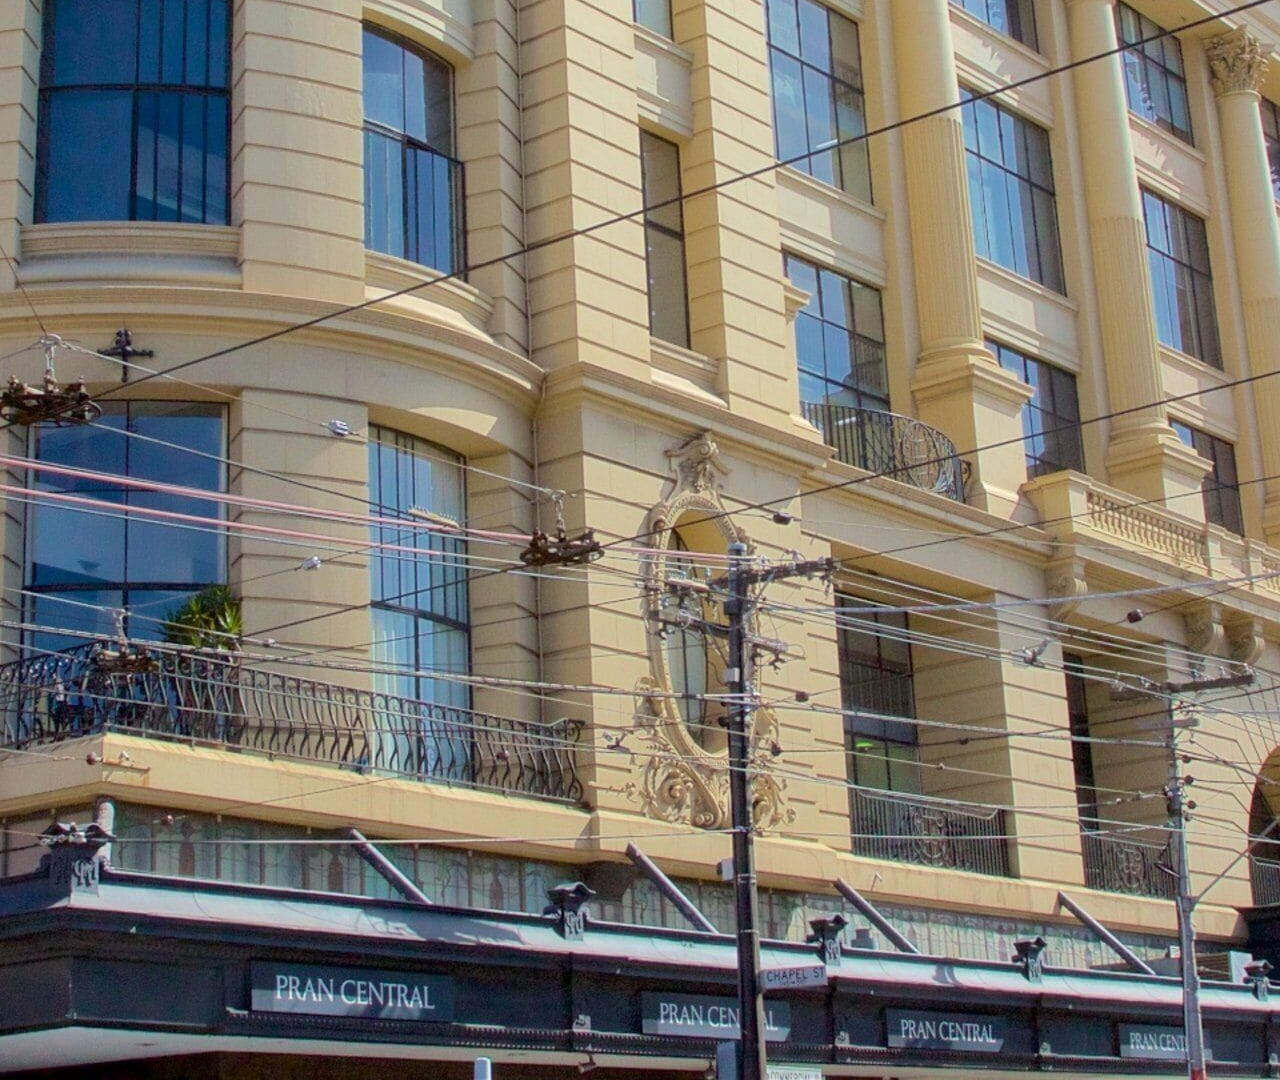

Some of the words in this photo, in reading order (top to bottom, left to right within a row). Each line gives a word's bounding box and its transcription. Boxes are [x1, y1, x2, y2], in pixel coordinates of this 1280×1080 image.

[767, 970, 809, 983] CHAPEL
[813, 968, 825, 979] ST
[275, 975, 334, 1003] PRAN
[340, 979, 435, 1010] CENTRAL
[660, 1002, 703, 1026] PRAN
[707, 1005, 778, 1031] CENAL
[901, 1019, 936, 1040] PRAN
[938, 1021, 996, 1043] CENTRAL
[1130, 1032, 1158, 1050] PRAN
